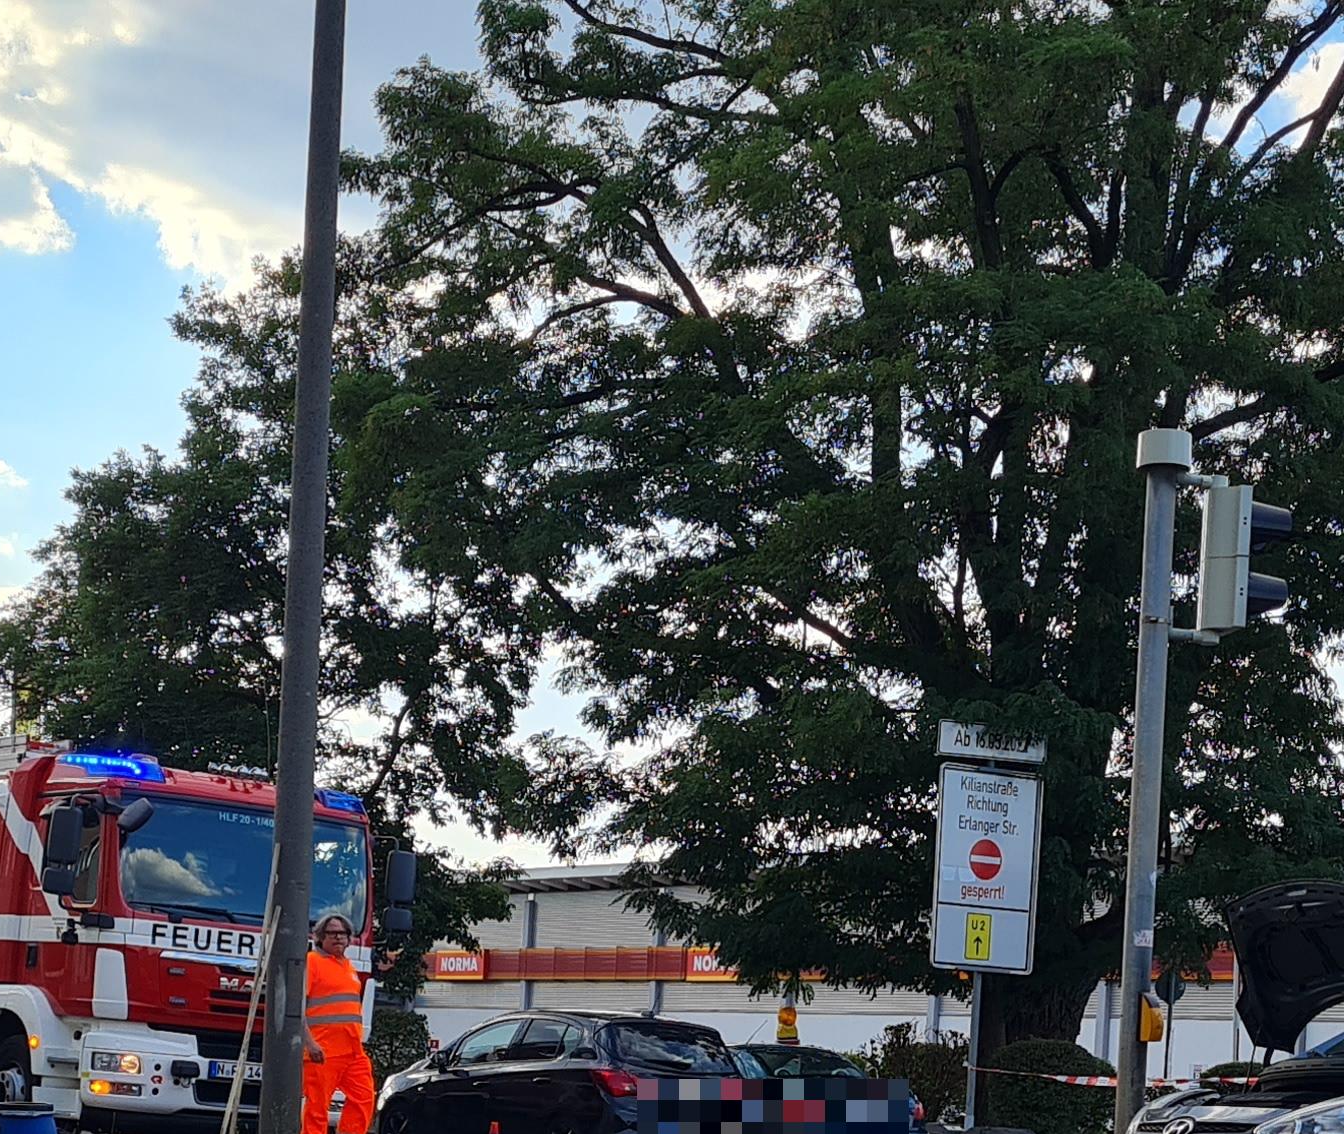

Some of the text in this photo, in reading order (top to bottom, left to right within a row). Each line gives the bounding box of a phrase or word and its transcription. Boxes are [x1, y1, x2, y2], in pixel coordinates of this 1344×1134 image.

[954, 729, 970, 747] Ab
[960, 775, 1019, 797] Kilianstraße
[966, 795, 1008, 817] Richtung
[958, 815, 1019, 836] Erlanger Str.
[960, 884, 1005, 901] gesperrt!
[152, 923, 260, 956] FEUER
[440, 957, 478, 972] NORMA
[217, 1063, 225, 1075] N
